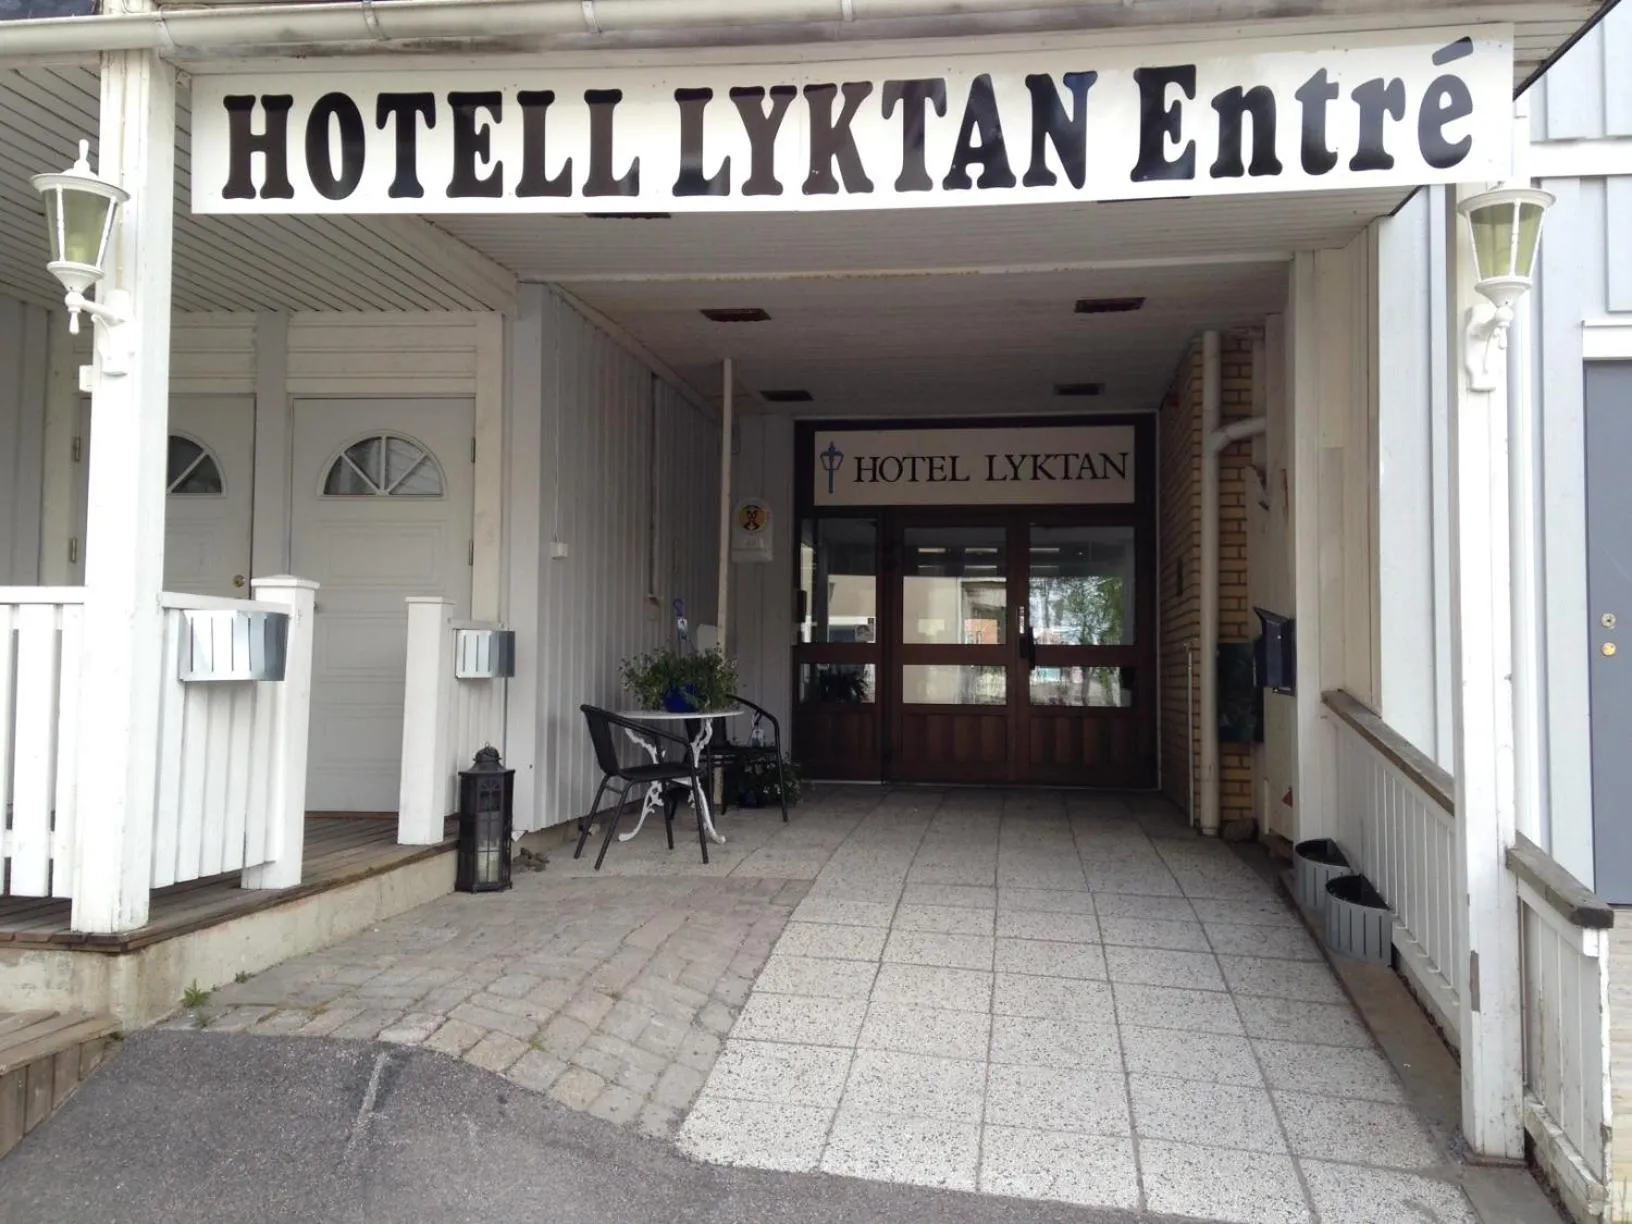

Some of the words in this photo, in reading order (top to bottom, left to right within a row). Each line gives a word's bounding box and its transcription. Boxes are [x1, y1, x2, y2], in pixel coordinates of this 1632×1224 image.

[222, 89, 640, 200] HOTELL
[672, 71, 1098, 196] LYKTAN
[1131, 35, 1474, 182] Entré
[853, 455, 971, 483] HOTEL
[984, 452, 1130, 481] LYKTAN
